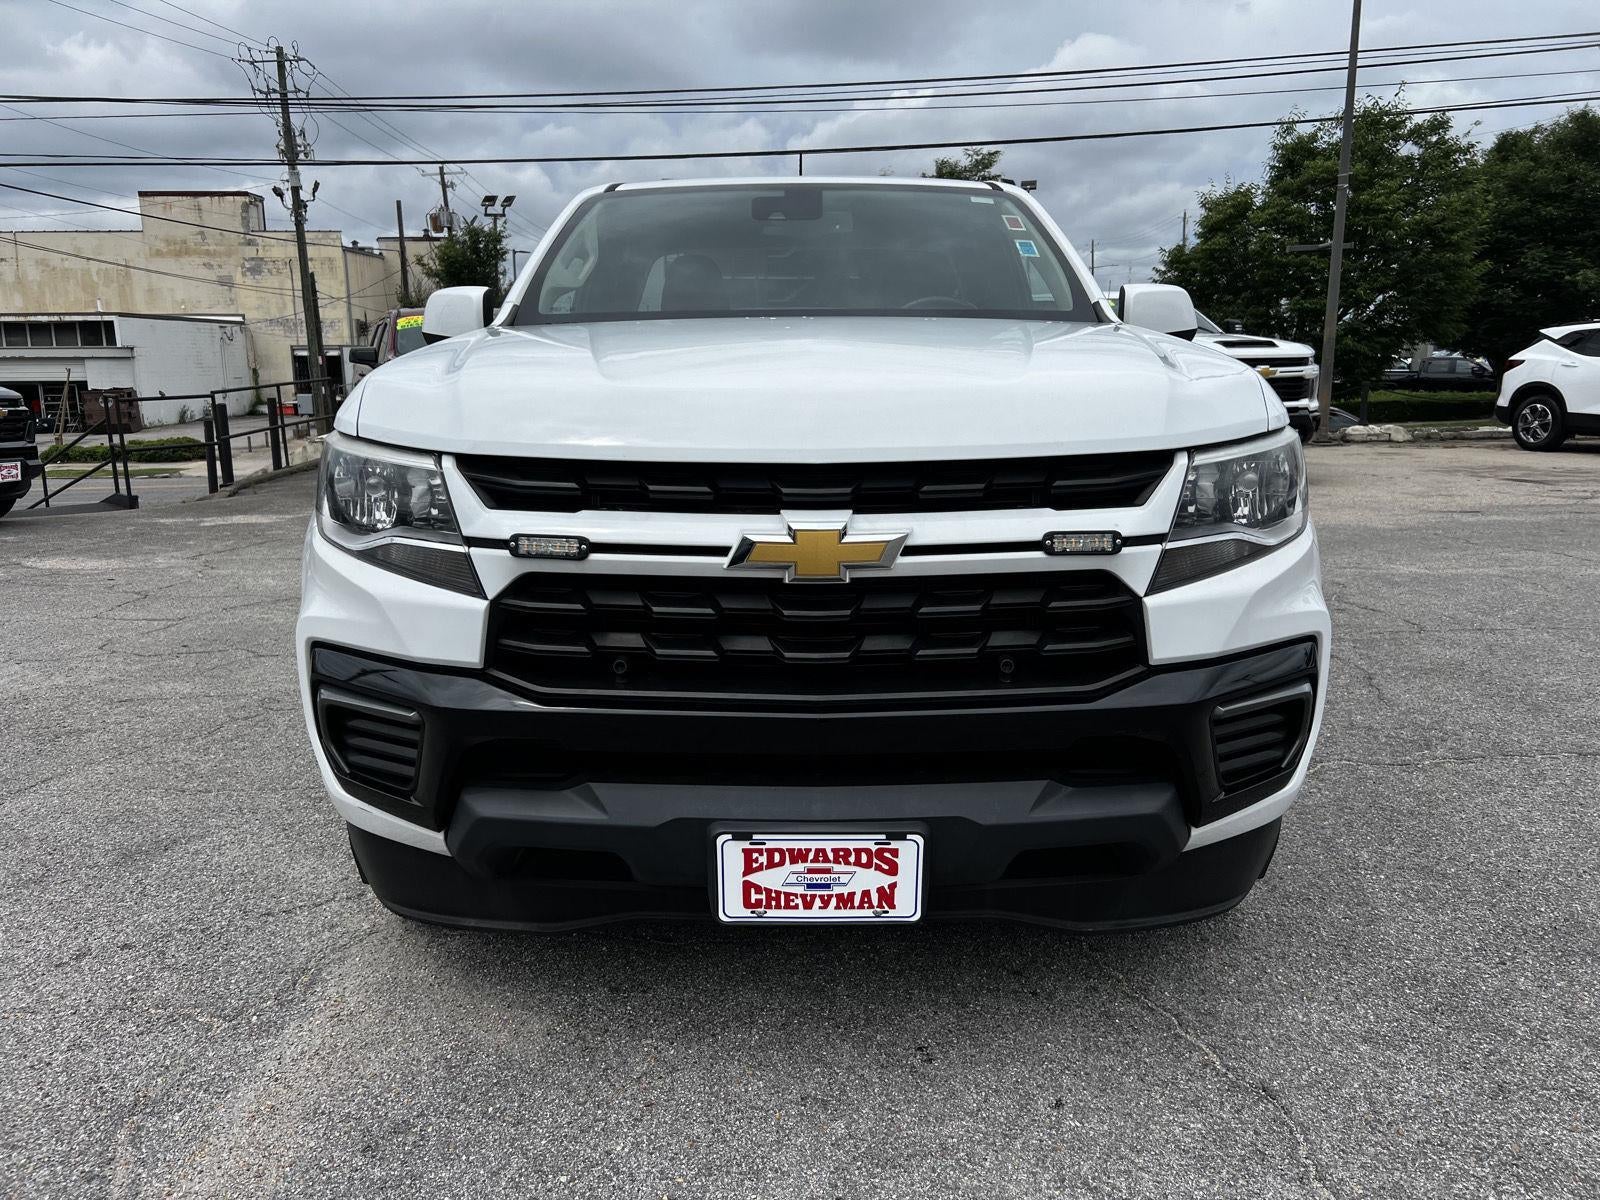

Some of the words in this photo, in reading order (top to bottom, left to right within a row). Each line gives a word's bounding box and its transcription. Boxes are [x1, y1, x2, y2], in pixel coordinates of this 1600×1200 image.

[742, 847, 899, 878] EDWARDS
[796, 874, 841, 883] Chevrolet
[742, 880, 897, 910] CHEVYMAN
